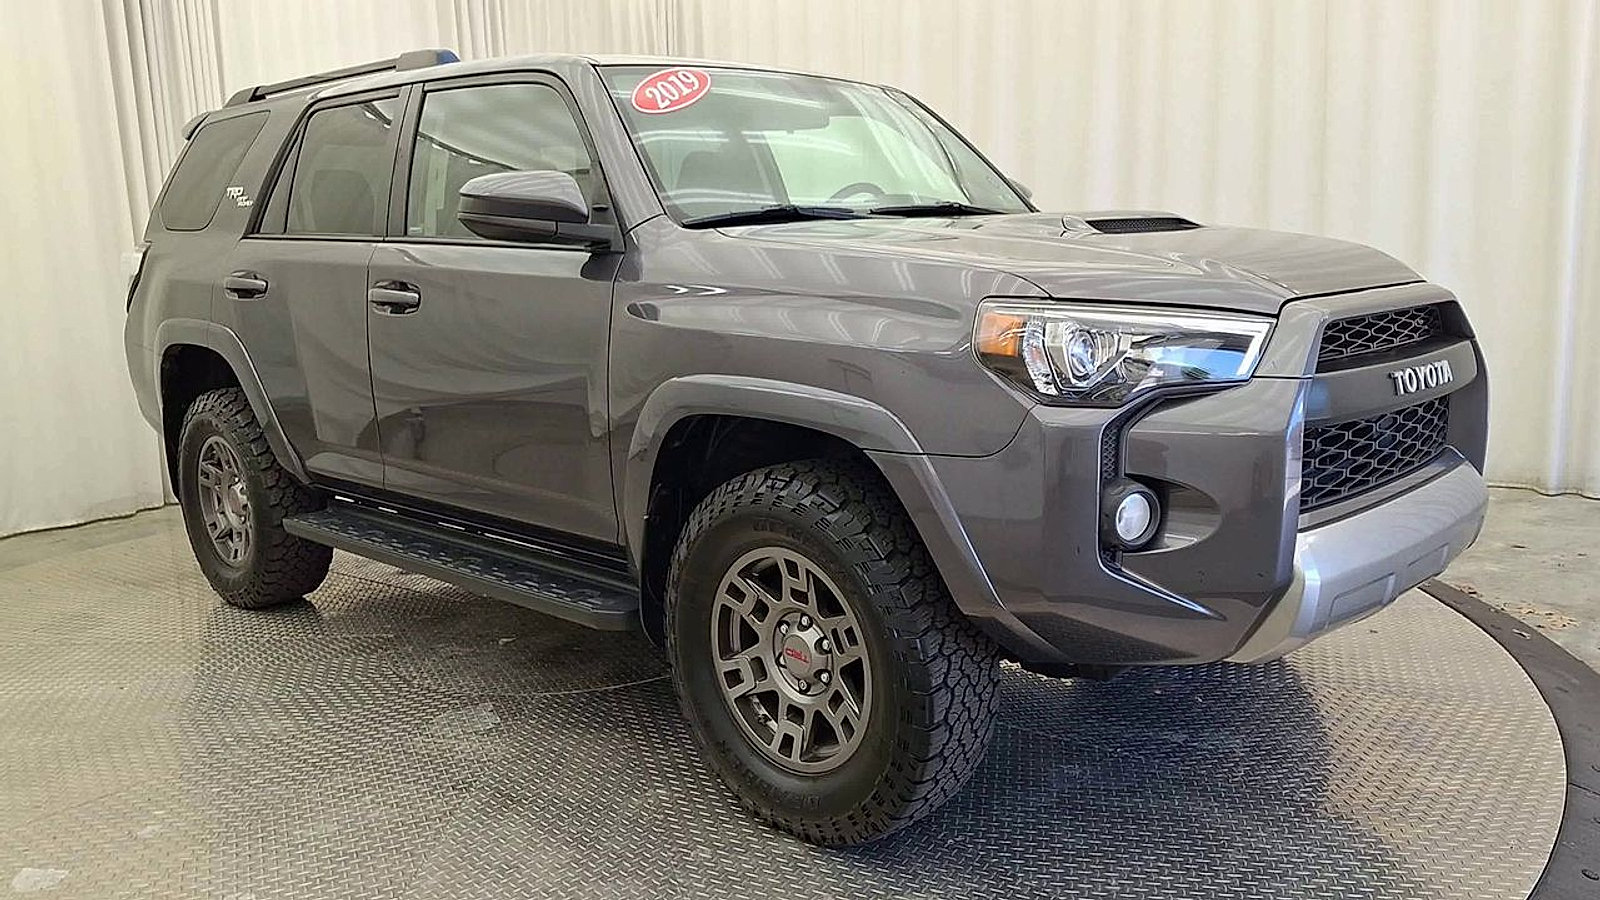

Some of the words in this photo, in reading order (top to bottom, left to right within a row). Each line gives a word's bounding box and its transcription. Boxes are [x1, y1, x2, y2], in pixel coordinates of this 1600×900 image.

[645, 71, 700, 109] 2019
[226, 186, 244, 200] TRD
[1391, 360, 1454, 395] TOYOTA
